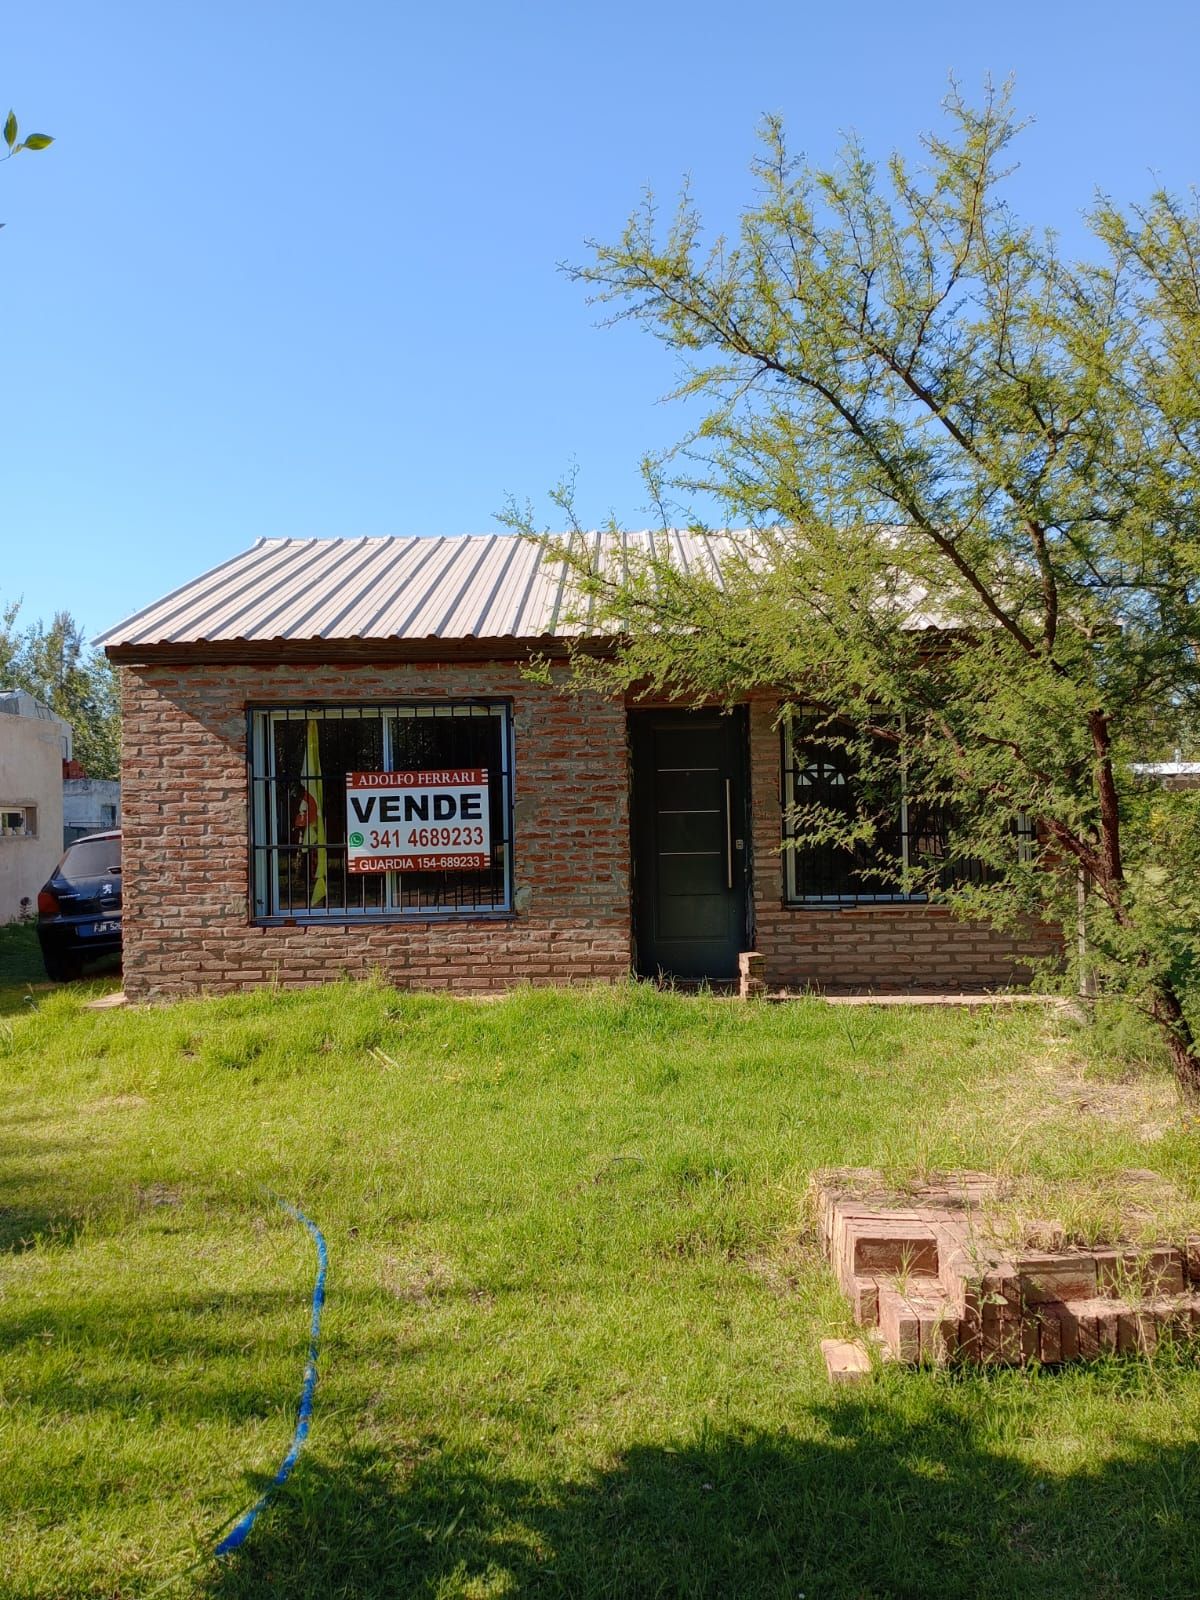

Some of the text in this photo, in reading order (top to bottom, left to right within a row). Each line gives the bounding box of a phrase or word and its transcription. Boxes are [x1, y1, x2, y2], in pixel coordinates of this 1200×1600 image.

[358, 771, 475, 786] ADOLFO FERRARI
[350, 793, 482, 823] VENDE
[369, 826, 484, 849] 341 4689233
[359, 856, 480, 871] GUARDIA 154-689233
